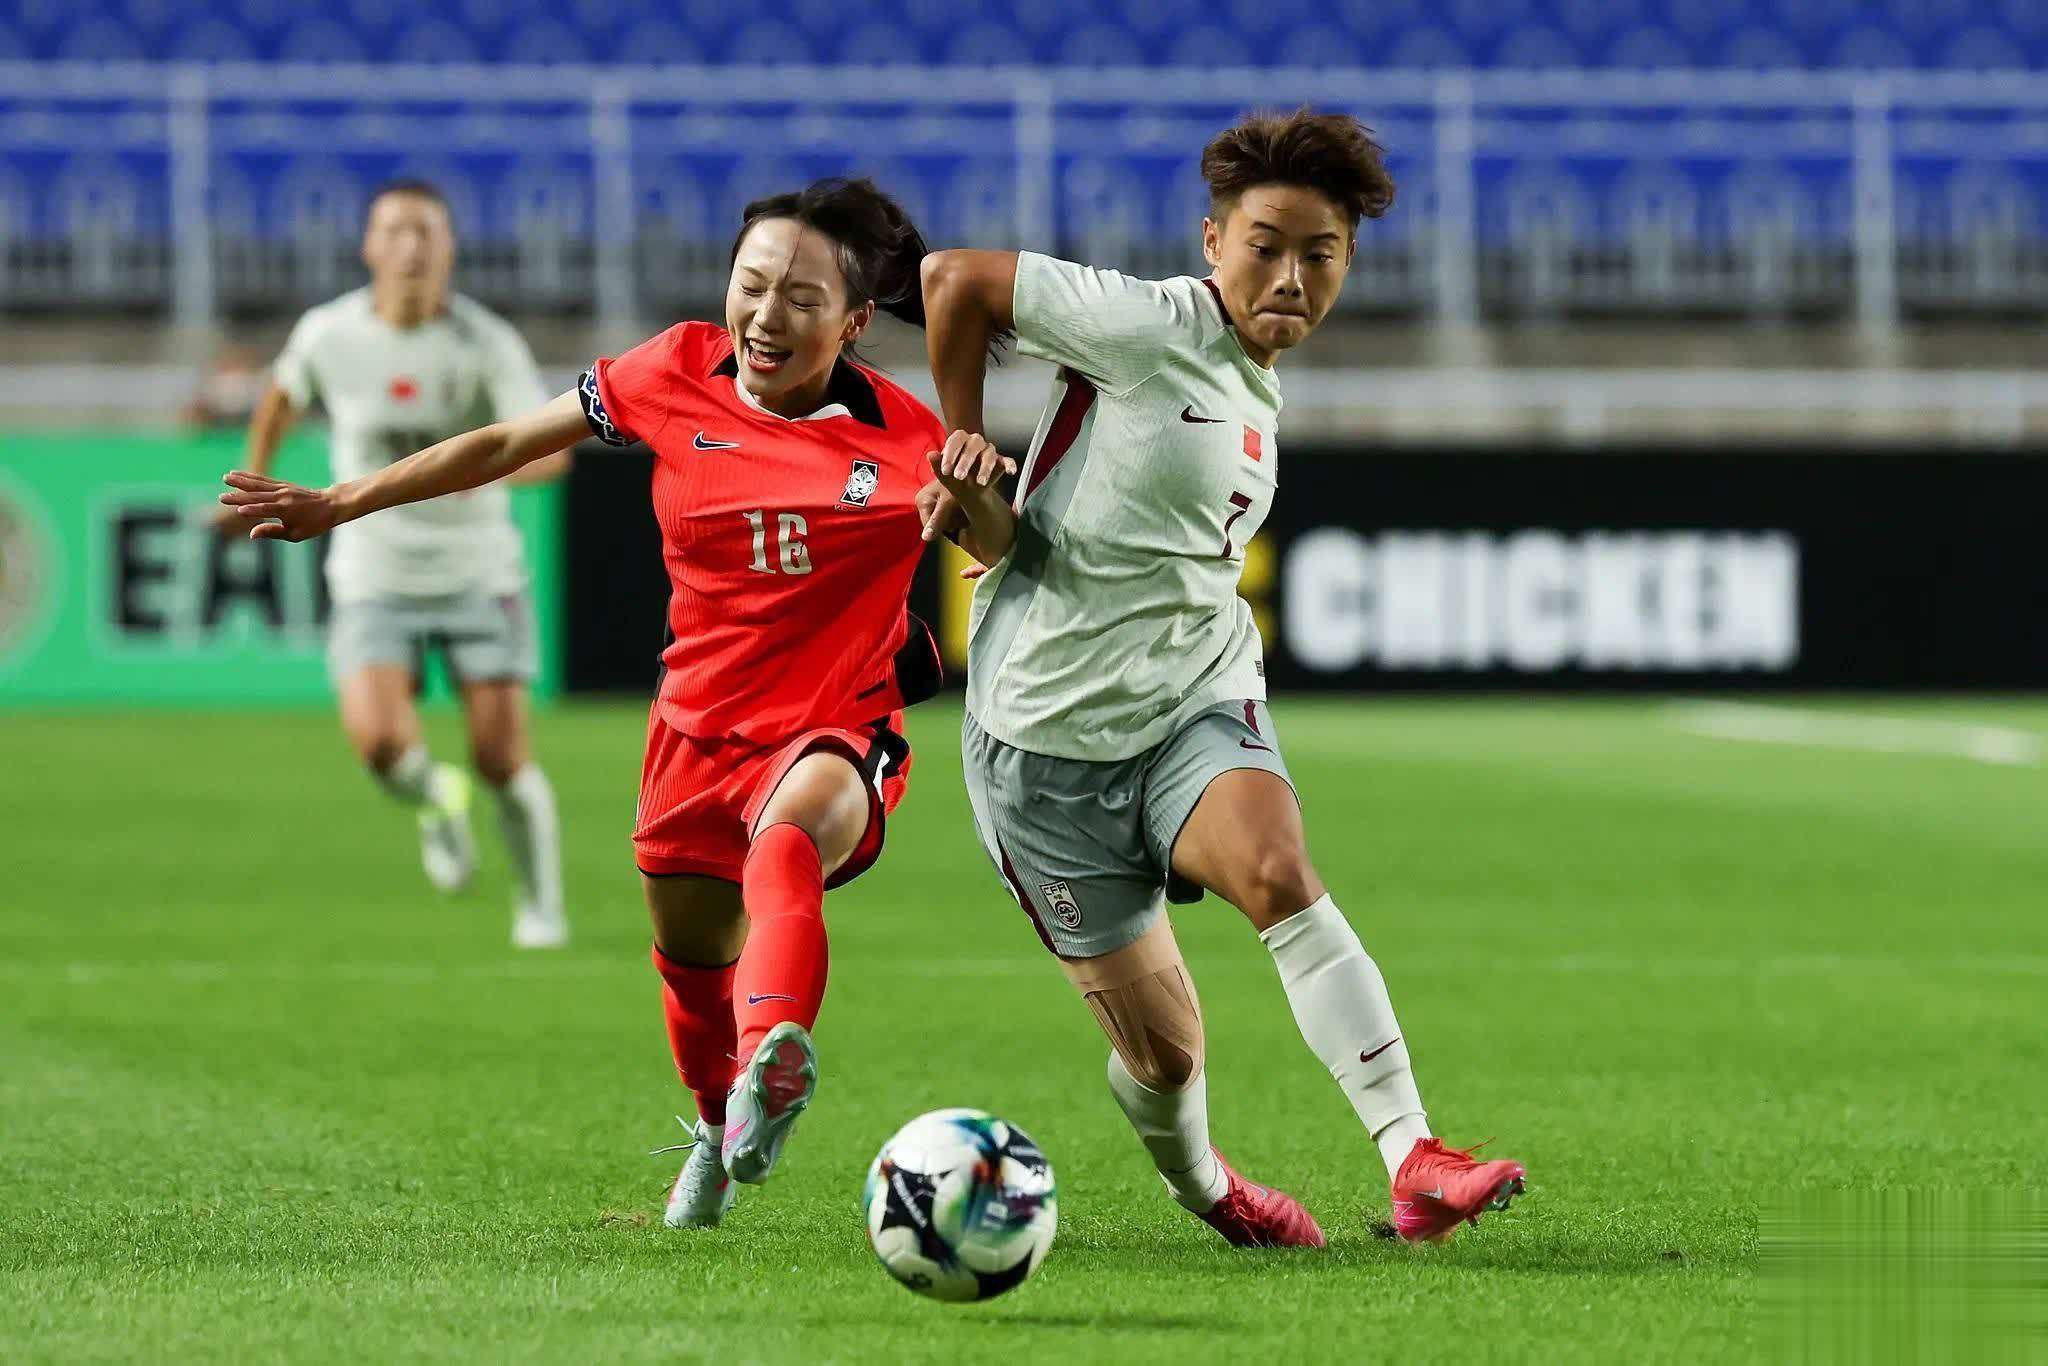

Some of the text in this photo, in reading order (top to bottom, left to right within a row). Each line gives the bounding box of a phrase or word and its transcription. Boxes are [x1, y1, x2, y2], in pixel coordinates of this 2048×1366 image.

[113, 505, 333, 633] EA
[742, 508, 813, 575] 16
[1221, 490, 1253, 560] 7
[1284, 527, 1798, 671] CHICKEN
